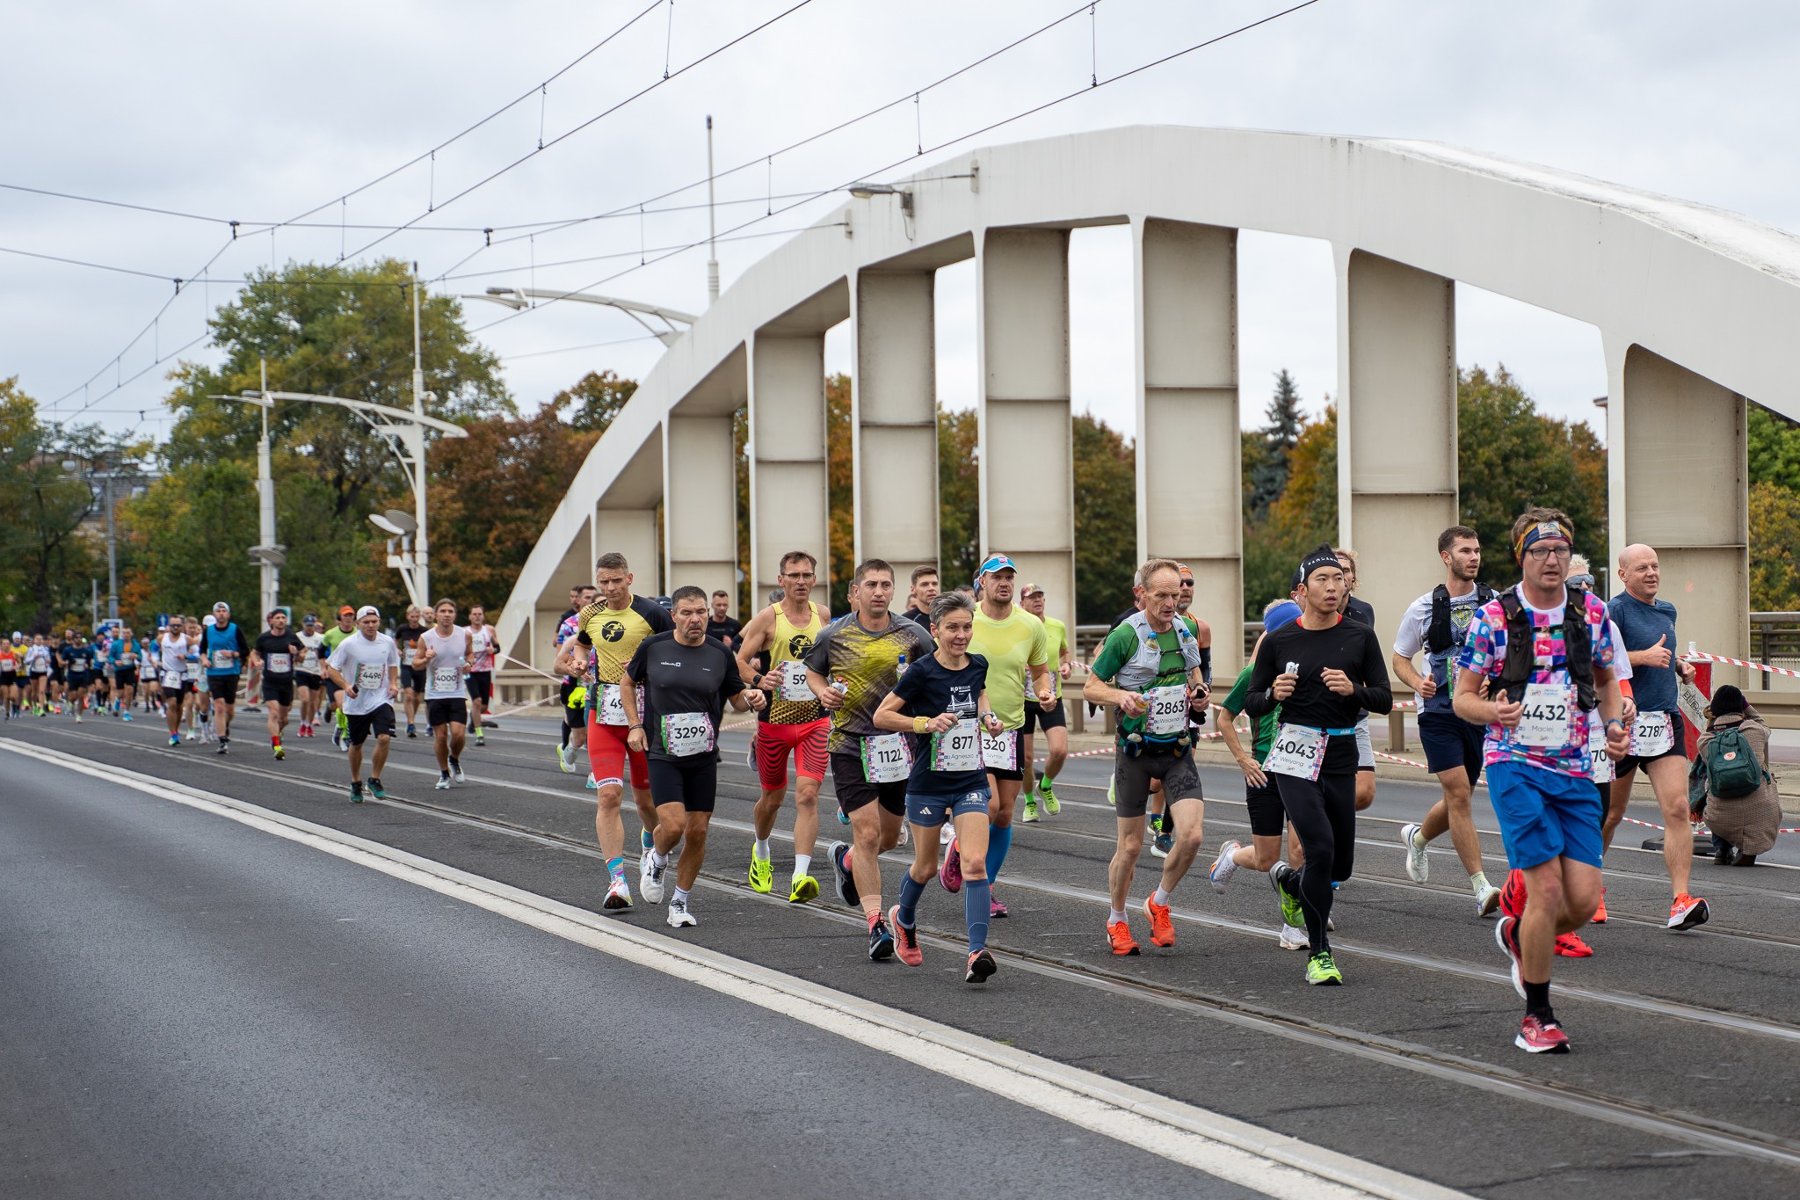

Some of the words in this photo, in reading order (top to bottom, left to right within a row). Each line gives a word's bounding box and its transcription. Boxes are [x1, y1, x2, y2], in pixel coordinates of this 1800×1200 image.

[362, 671, 381, 679] 4496
[436, 674, 456, 682] 4000
[792, 674, 807, 685] 59
[1155, 700, 1185, 715] 2863
[1522, 703, 1566, 720] 4432
[674, 725, 706, 739] 3299
[1638, 725, 1665, 738] 2787
[952, 735, 973, 750] 877
[983, 739, 1006, 752] 320
[1275, 739, 1317, 760] 4043
[878, 748, 903, 763] 1122
